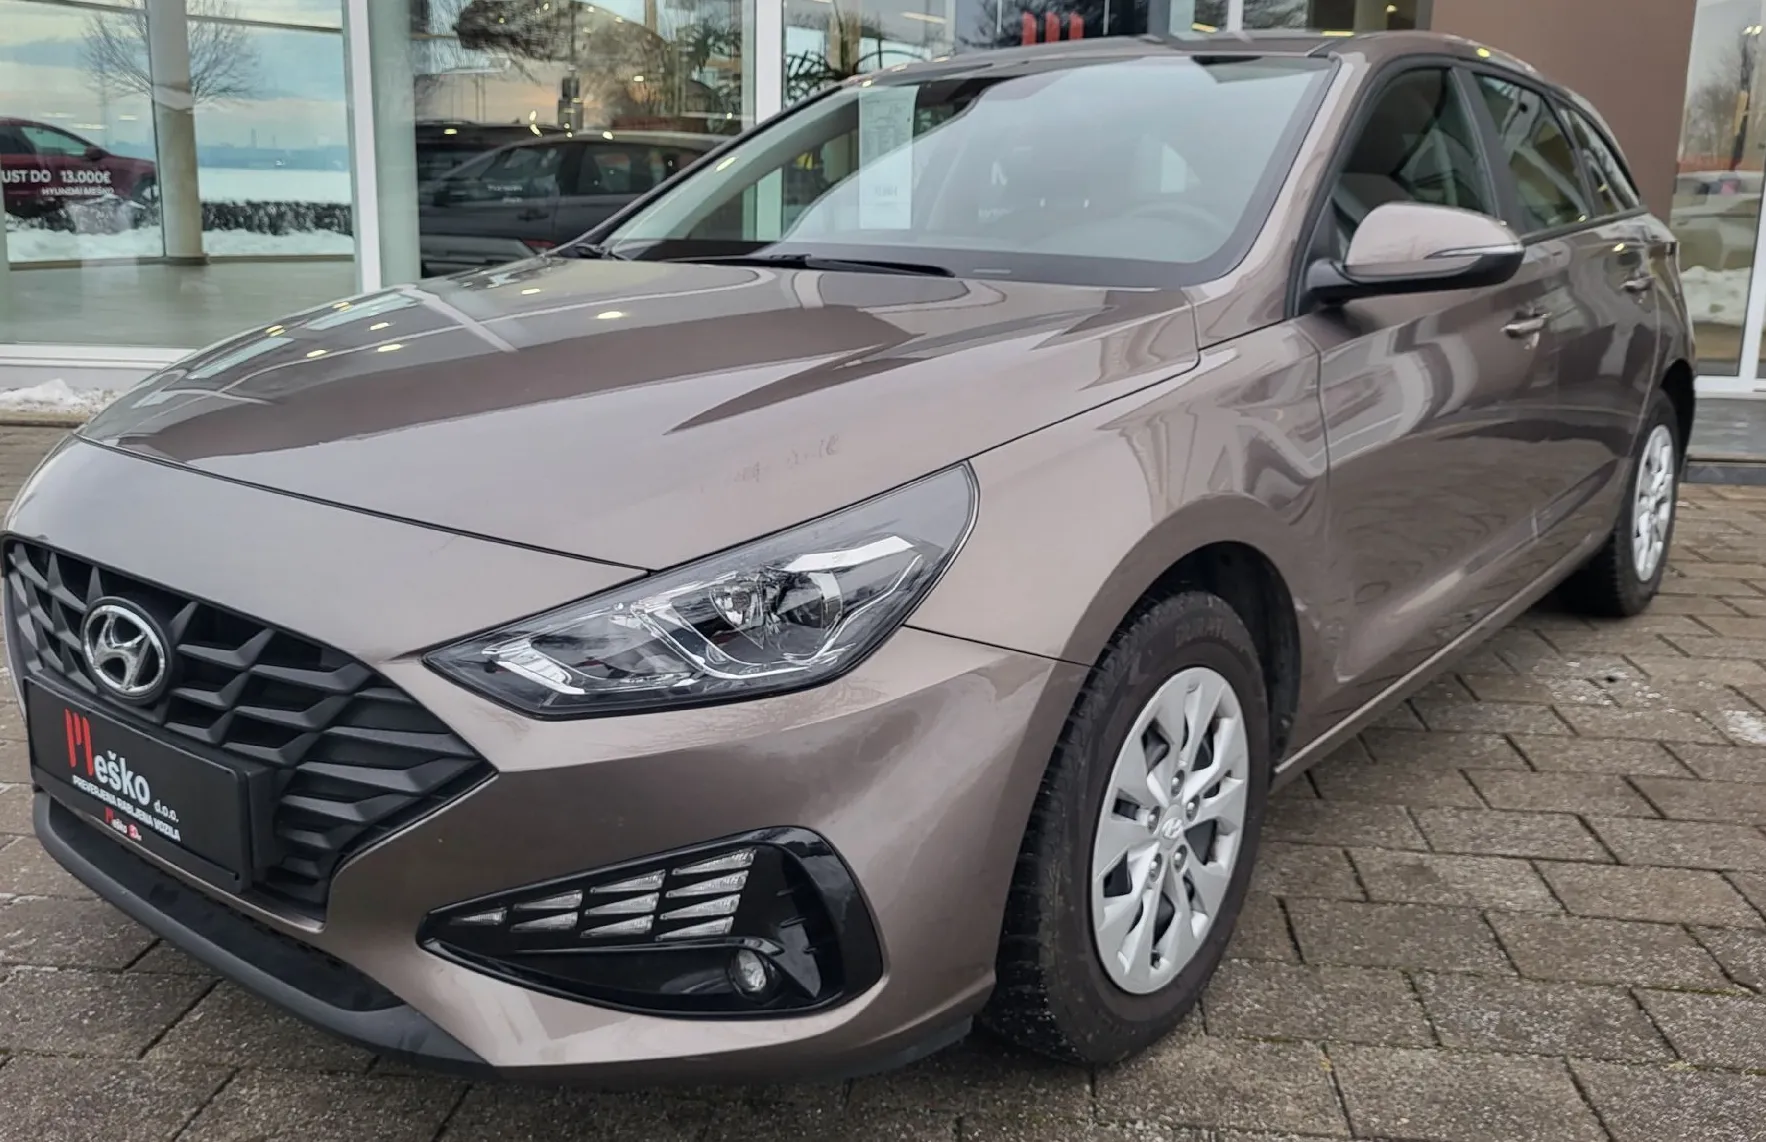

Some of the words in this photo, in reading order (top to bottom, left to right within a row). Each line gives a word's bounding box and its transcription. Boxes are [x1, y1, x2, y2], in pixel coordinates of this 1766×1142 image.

[30, 169, 51, 183] DO
[61, 169, 111, 184] 13.000€
[41, 186, 82, 196] HYUNDAI
[65, 708, 150, 805] Meško
